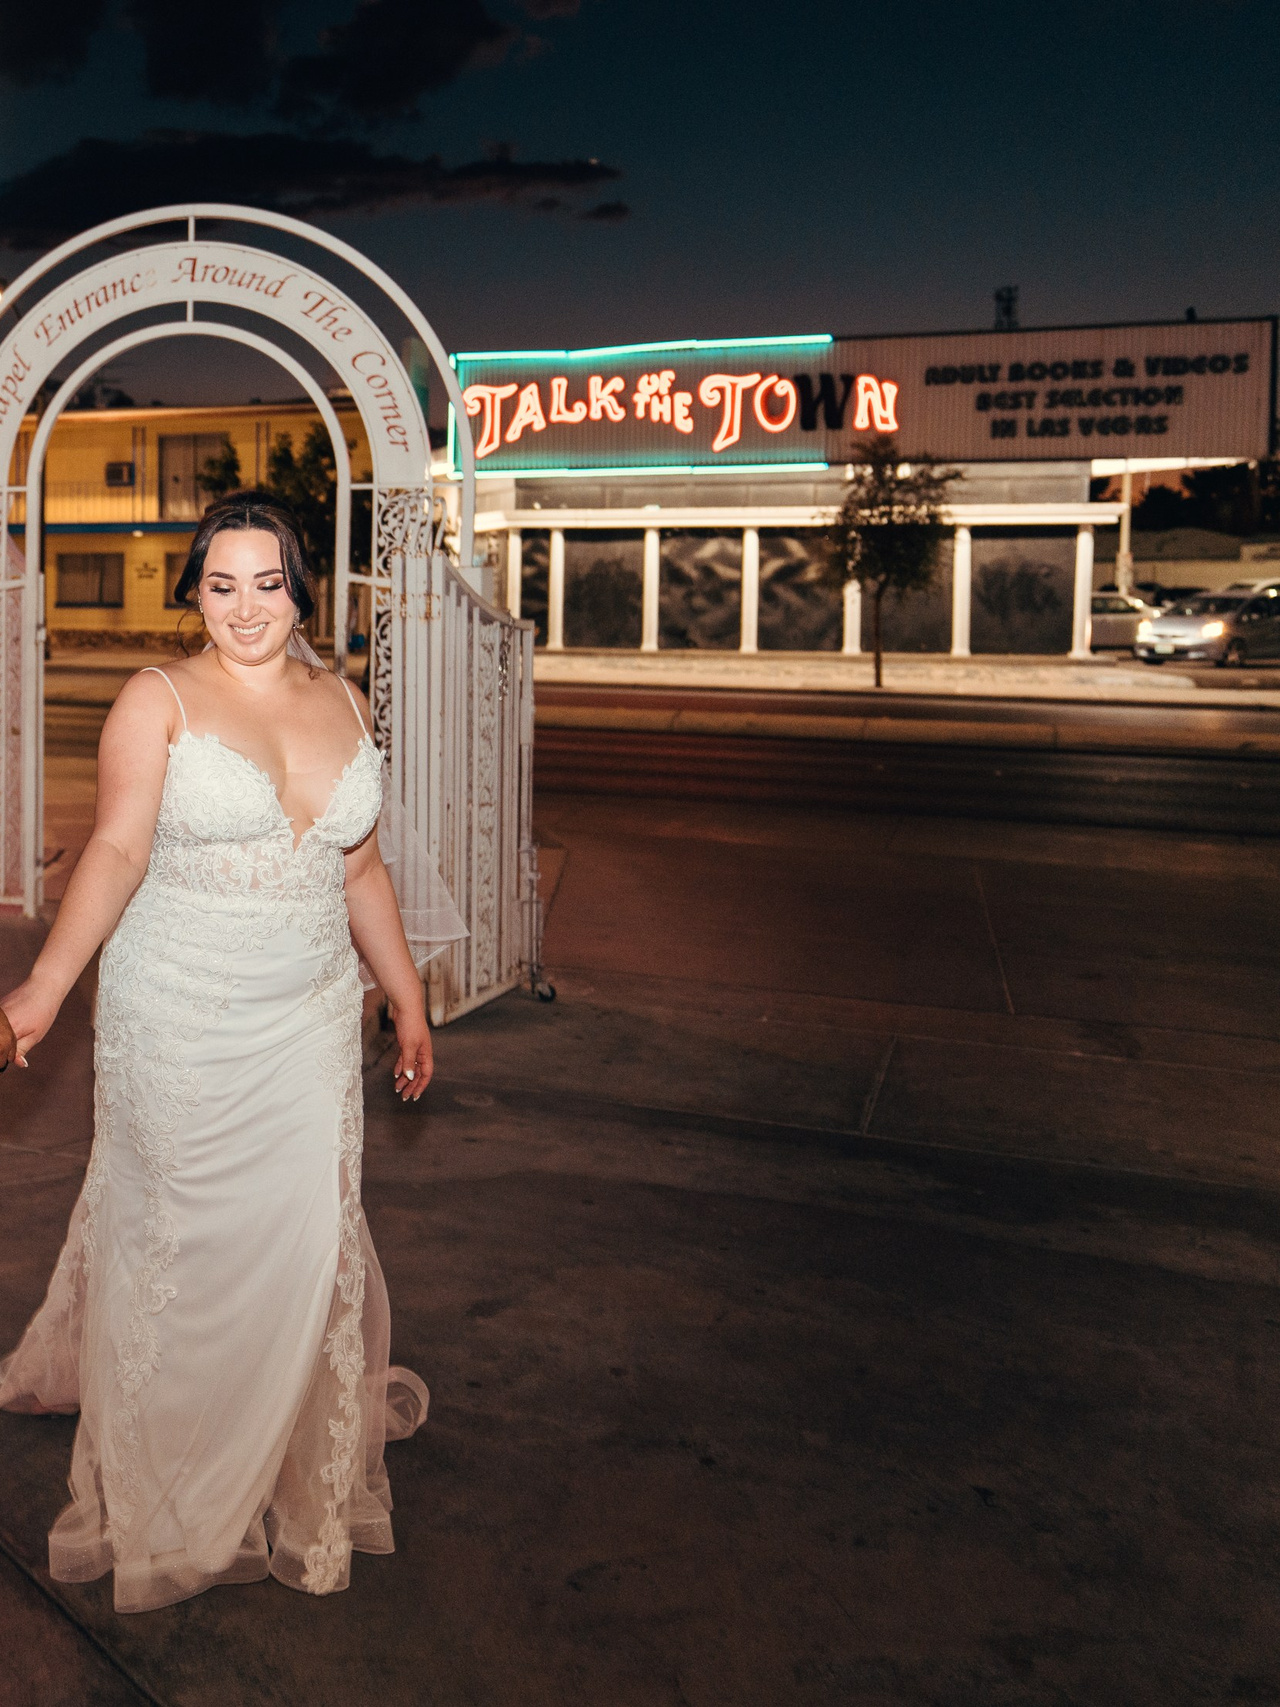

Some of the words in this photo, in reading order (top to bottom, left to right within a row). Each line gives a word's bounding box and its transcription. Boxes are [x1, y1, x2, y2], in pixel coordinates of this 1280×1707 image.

[171, 256, 298, 299] Around
[300, 290, 353, 343] The
[350, 350, 410, 453] Corner
[924, 363, 1001, 386] ADULT
[1007, 359, 1104, 382] BOOKS
[1112, 357, 1135, 378] &
[1144, 352, 1250, 377] VIDEOS
[637, 370, 676, 395] OF
[975, 390, 1038, 411] BEST
[1044, 385, 1184, 409] SELECTION
[462, 375, 626, 459] TALK
[632, 391, 695, 434] THE
[699, 373, 899, 453] TOWN
[990, 418, 1017, 439] IN
[1026, 417, 1070, 438] LAS
[1077, 415, 1169, 437] VEGAS
